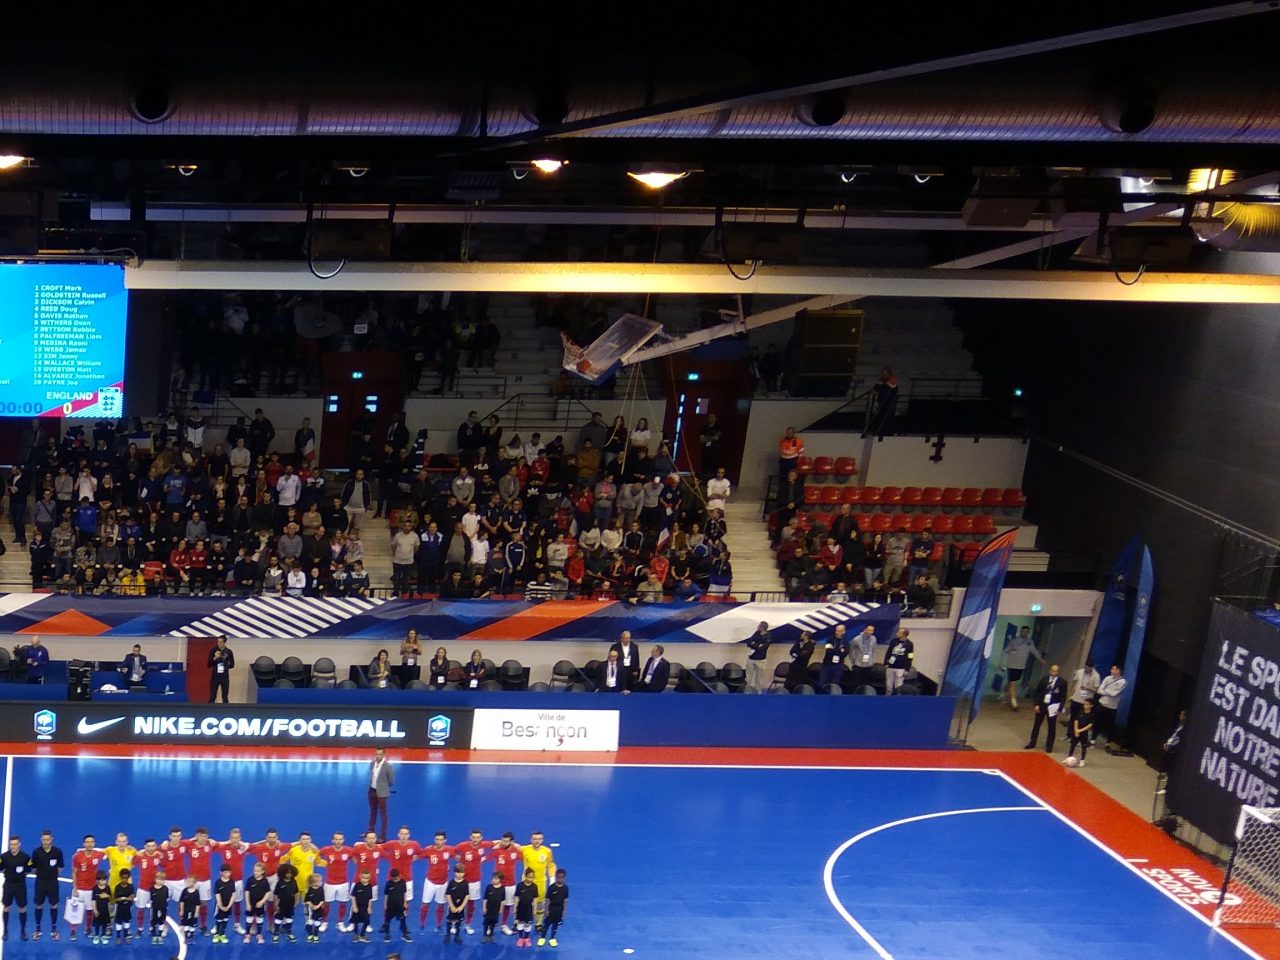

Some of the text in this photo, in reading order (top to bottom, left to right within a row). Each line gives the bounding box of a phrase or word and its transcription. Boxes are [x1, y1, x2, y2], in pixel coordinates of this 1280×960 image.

[46, 391, 93, 400] ENGLAND
[62, 402, 72, 415] 0
[1218, 639, 1250, 676] LE
[1209, 673, 1251, 717] EST
[134, 716, 406, 739] NIKE.COM/FOOTBALL
[538, 713, 554, 721] Ville
[1200, 746, 1280, 809] NATURE
[1141, 868, 1209, 905] SPORTS
